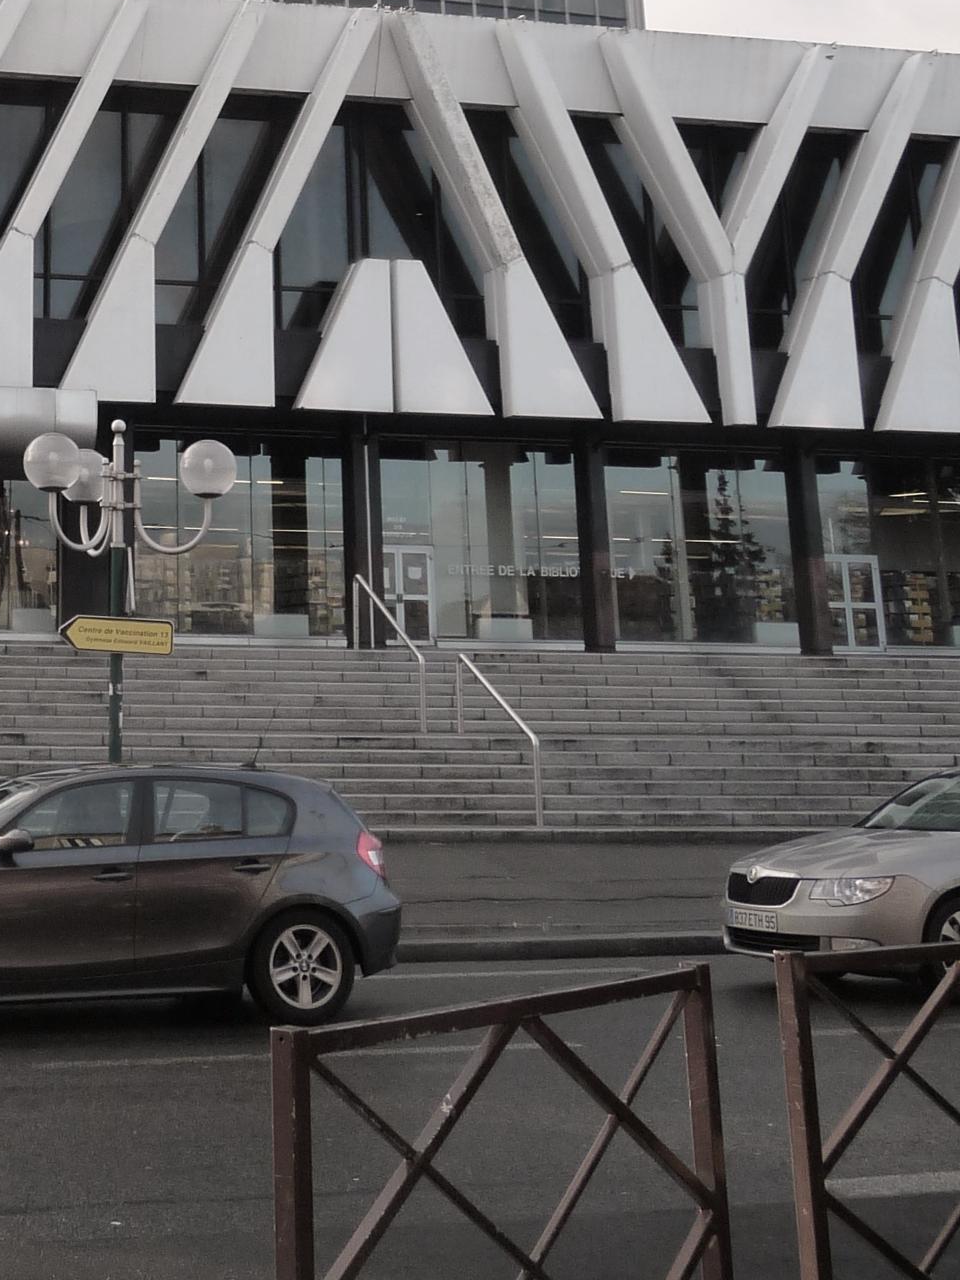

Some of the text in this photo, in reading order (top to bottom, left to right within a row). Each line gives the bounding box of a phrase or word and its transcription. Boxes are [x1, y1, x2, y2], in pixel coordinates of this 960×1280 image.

[498, 564, 515, 577] DE
[520, 565, 536, 577] LA
[78, 626, 102, 635] Centre
[104, 627, 113, 635] de
[115, 628, 158, 638] Vaccination
[765, 914, 776, 929] 95
